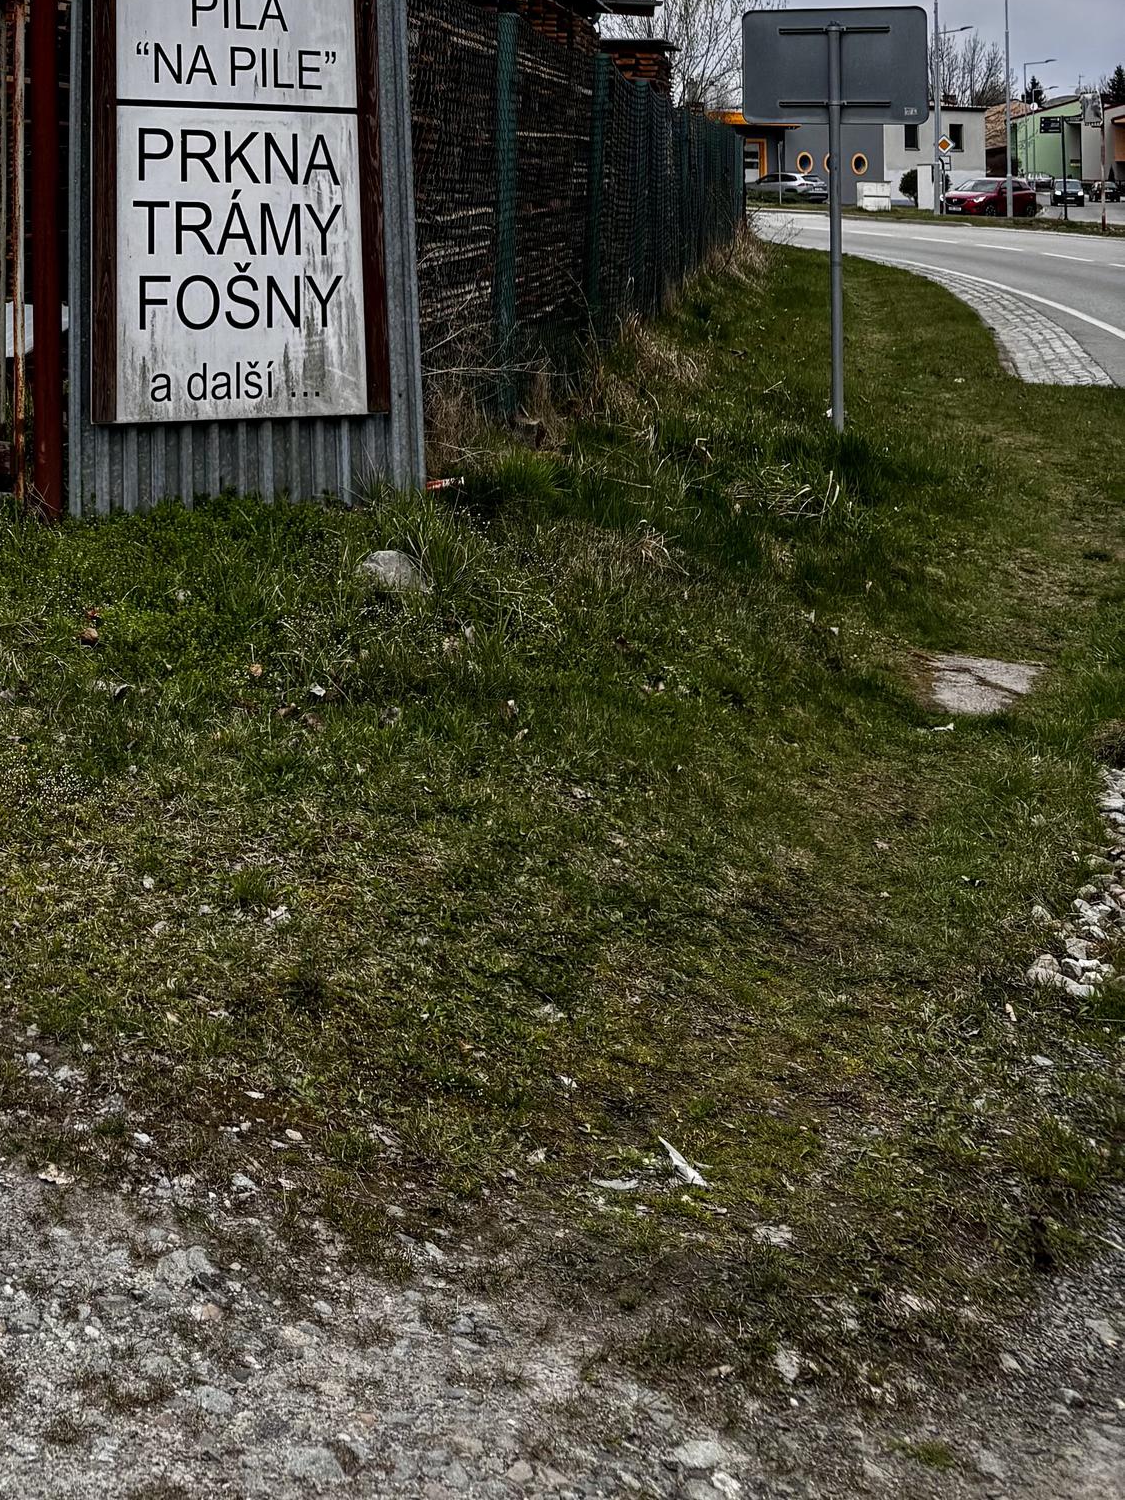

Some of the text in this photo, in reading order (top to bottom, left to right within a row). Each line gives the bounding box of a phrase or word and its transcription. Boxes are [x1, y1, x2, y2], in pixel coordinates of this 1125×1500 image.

[136, 41, 337, 91] “NA PILE”
[137, 127, 340, 186] PRKNA
[133, 189, 342, 256] TRÁMY
[139, 262, 343, 331] FOŠNY
[150, 372, 172, 402] a
[187, 361, 273, 401] další
